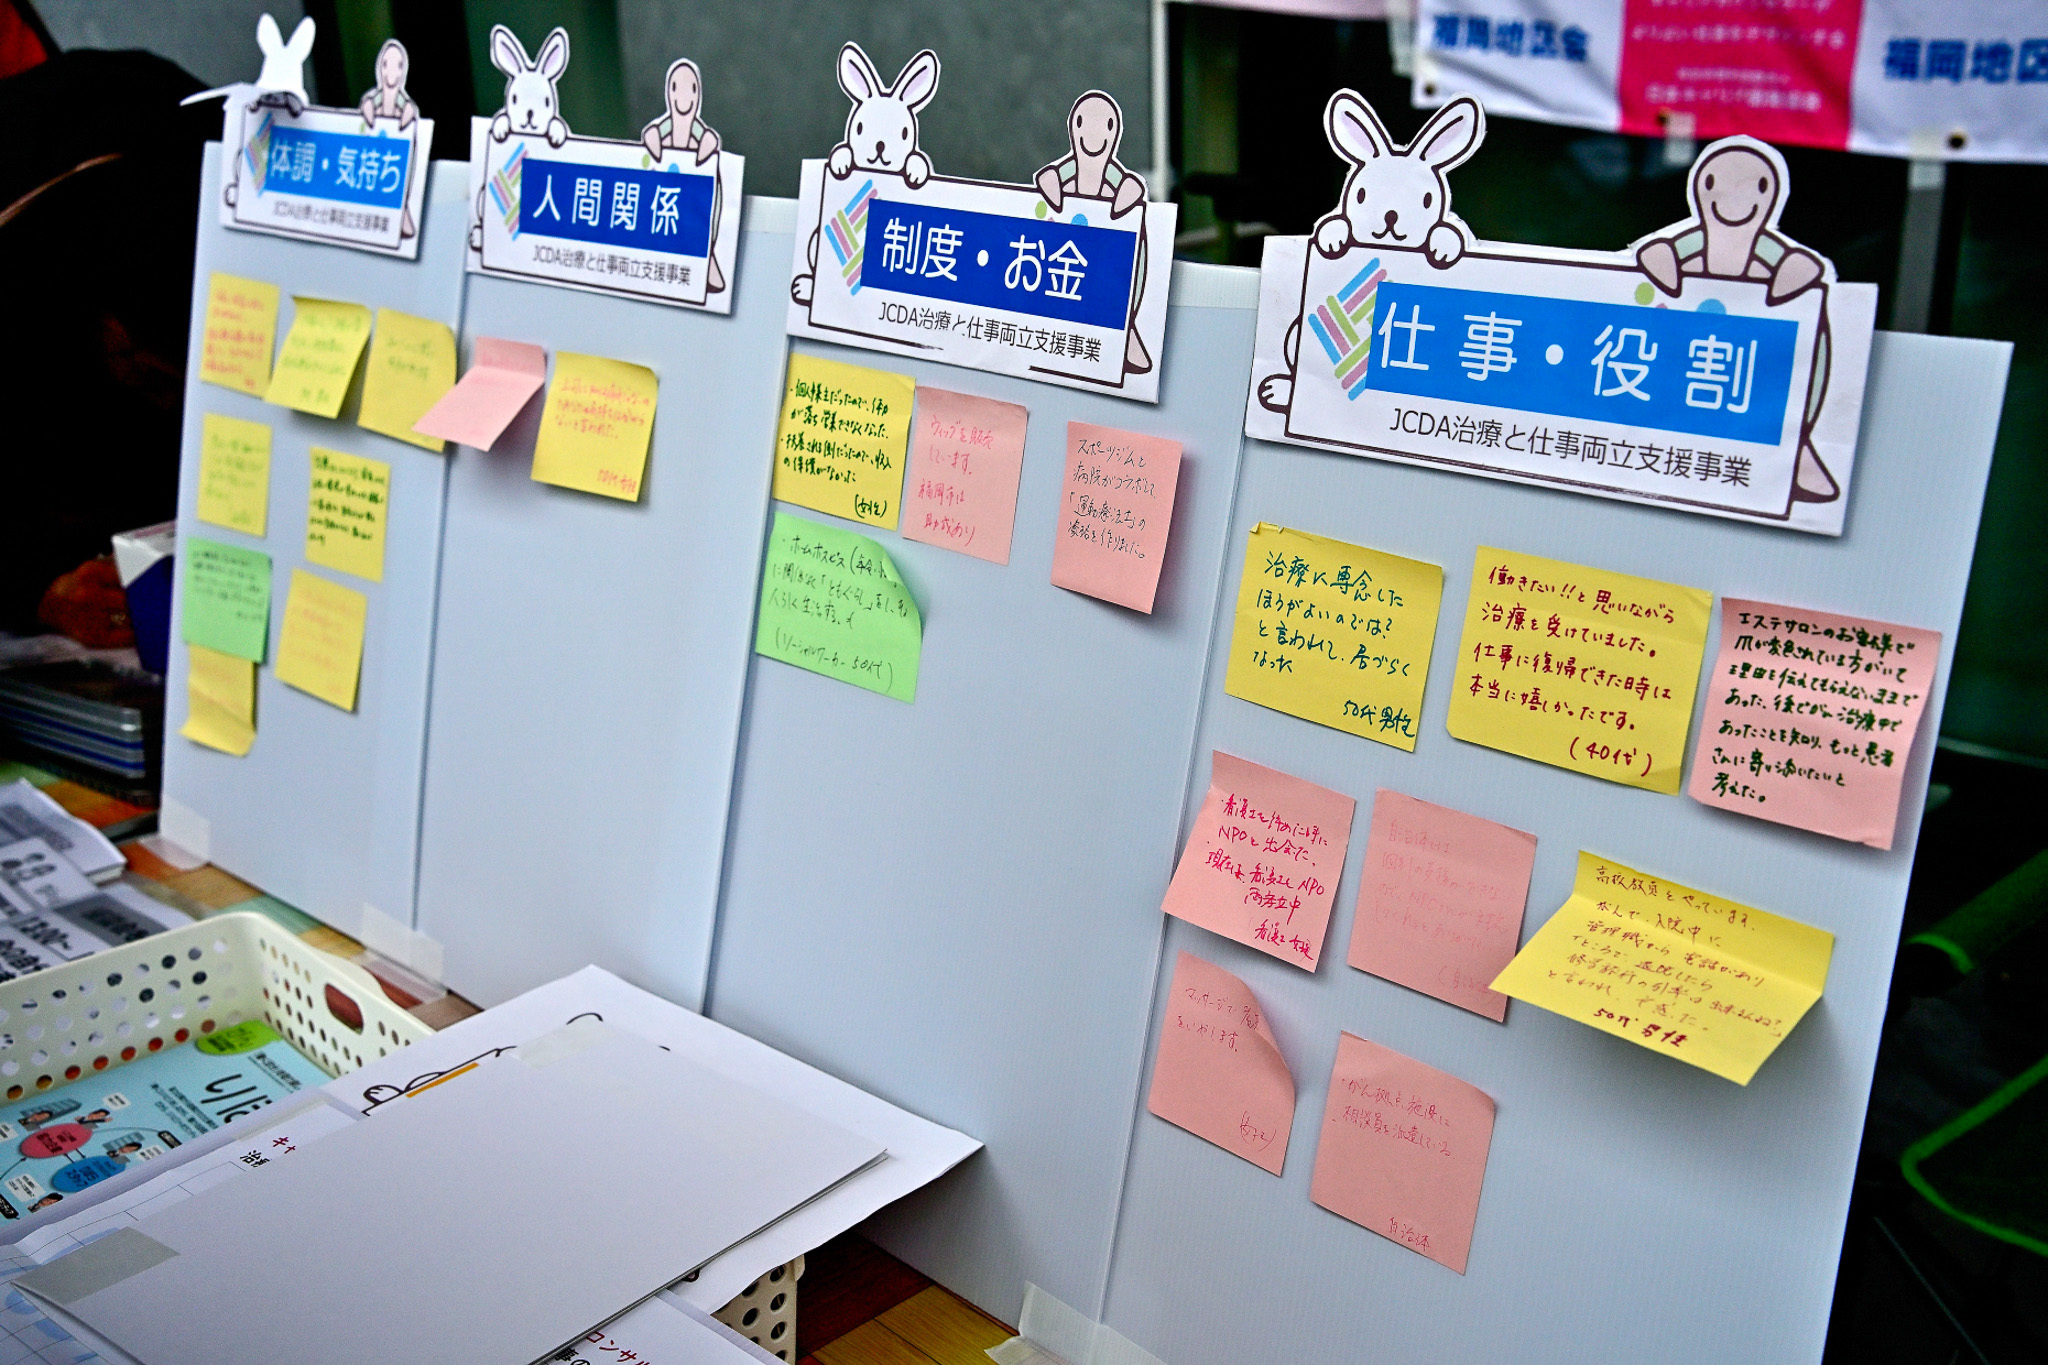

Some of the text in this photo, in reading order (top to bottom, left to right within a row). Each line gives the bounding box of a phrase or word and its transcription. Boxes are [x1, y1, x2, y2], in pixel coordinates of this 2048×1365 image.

[270, 139, 402, 194] 体調・気持ち
[531, 172, 681, 238] 人間関係
[532, 240, 692, 287] JCDA治療と仕事両立支援事業
[881, 216, 1089, 302] 制度・お金
[877, 301, 1102, 363] JCDA治療と仕事両立支援事業
[1376, 300, 1759, 415] 仕事・役割
[1077, 439, 1147, 468] スポーツジムと
[1387, 406, 1753, 490] JCDA治療と仕事両立支援事業
[1264, 550, 1404, 608] 治療に専念した
[1481, 601, 1657, 658] 治療を受けていました。
[1738, 612, 1915, 658] エステサロンのお客様で
[1253, 650, 1293, 674] なった
[1473, 641, 1672, 701] 仕事に復帰できた時は
[1342, 699, 1416, 738] 50代男性
[1469, 672, 1635, 731] 本当に嬉しかったです。
[1569, 736, 1652, 778] (40代)
[1712, 746, 1846, 787] さんに寄り添いたいと
[1711, 772, 1766, 803] 考えた。
[1586, 919, 1765, 986] 管理職から電話があり
[1389, 1216, 1430, 1251] 自治体
